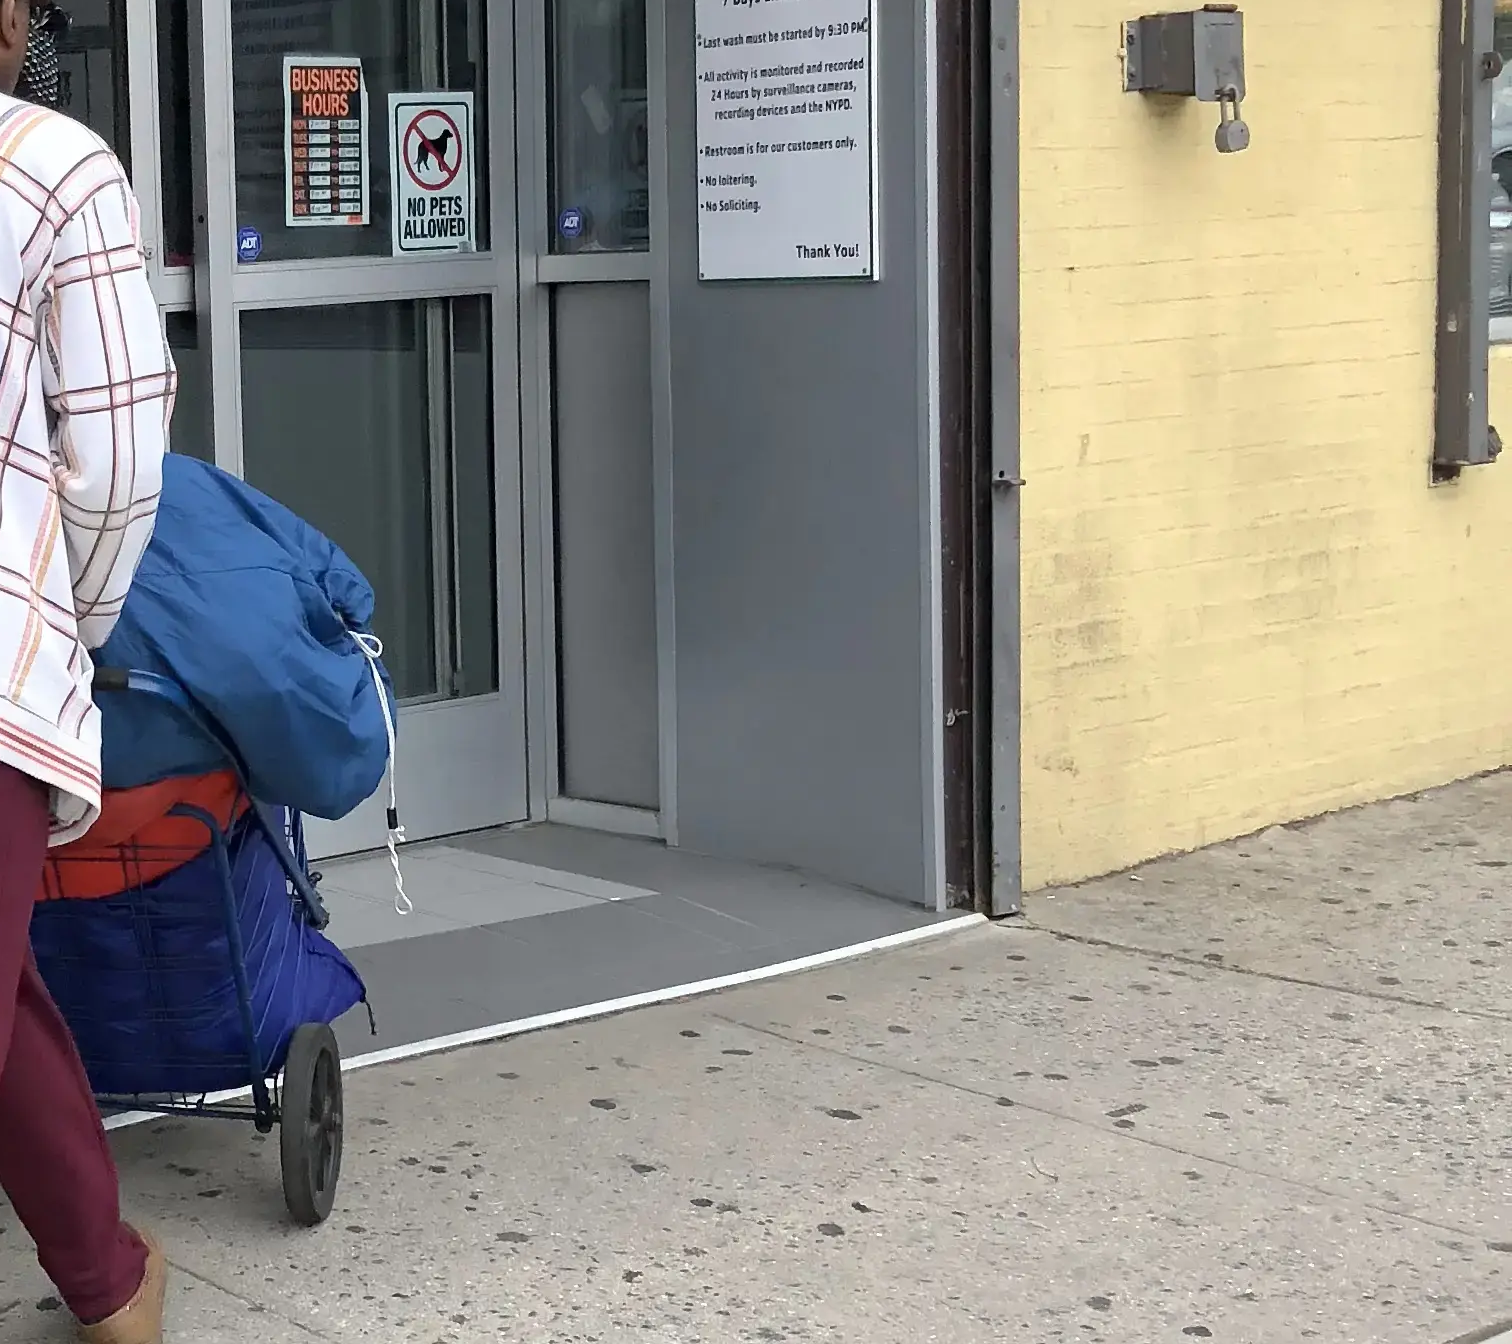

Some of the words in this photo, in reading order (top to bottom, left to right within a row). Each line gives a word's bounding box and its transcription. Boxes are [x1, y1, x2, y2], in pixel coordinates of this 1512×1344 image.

[703, 37, 720, 48] Last
[723, 34, 743, 46] wash
[745, 33, 767, 44] must
[769, 31, 779, 42] be
[780, 27, 813, 41] started
[815, 26, 825, 40] by
[828, 23, 849, 37] 9:30
[703, 71, 714, 82] All
[716, 68, 748, 82] activity
[750, 67, 758, 79] is
[760, 63, 804, 78] monitored
[806, 61, 822, 74] and
[824, 58, 864, 72] recorded
[292, 69, 359, 92] BUSINESS
[711, 89, 721, 101] 24
[724, 88, 748, 100] Hours
[751, 87, 761, 100] by
[763, 83, 815, 98] surveillance
[302, 94, 349, 116] HOURS
[714, 107, 754, 121] recording
[756, 105, 788, 118] devices
[790, 102, 807, 115] and
[808, 100, 823, 113] the
[705, 146, 744, 157] Restroom
[746, 143, 754, 154] is
[756, 142, 768, 154] for
[770, 142, 786, 153] our
[787, 139, 833, 151] customers
[705, 175, 717, 187] No
[408, 197, 426, 217] NO
[430, 196, 462, 215] PETS
[705, 201, 717, 212] No
[404, 218, 465, 239] ALLOWED
[564, 217, 579, 228] ADT
[241, 237, 257, 250] ADT
[796, 244, 831, 258] Thank
[833, 244, 859, 258] You!
